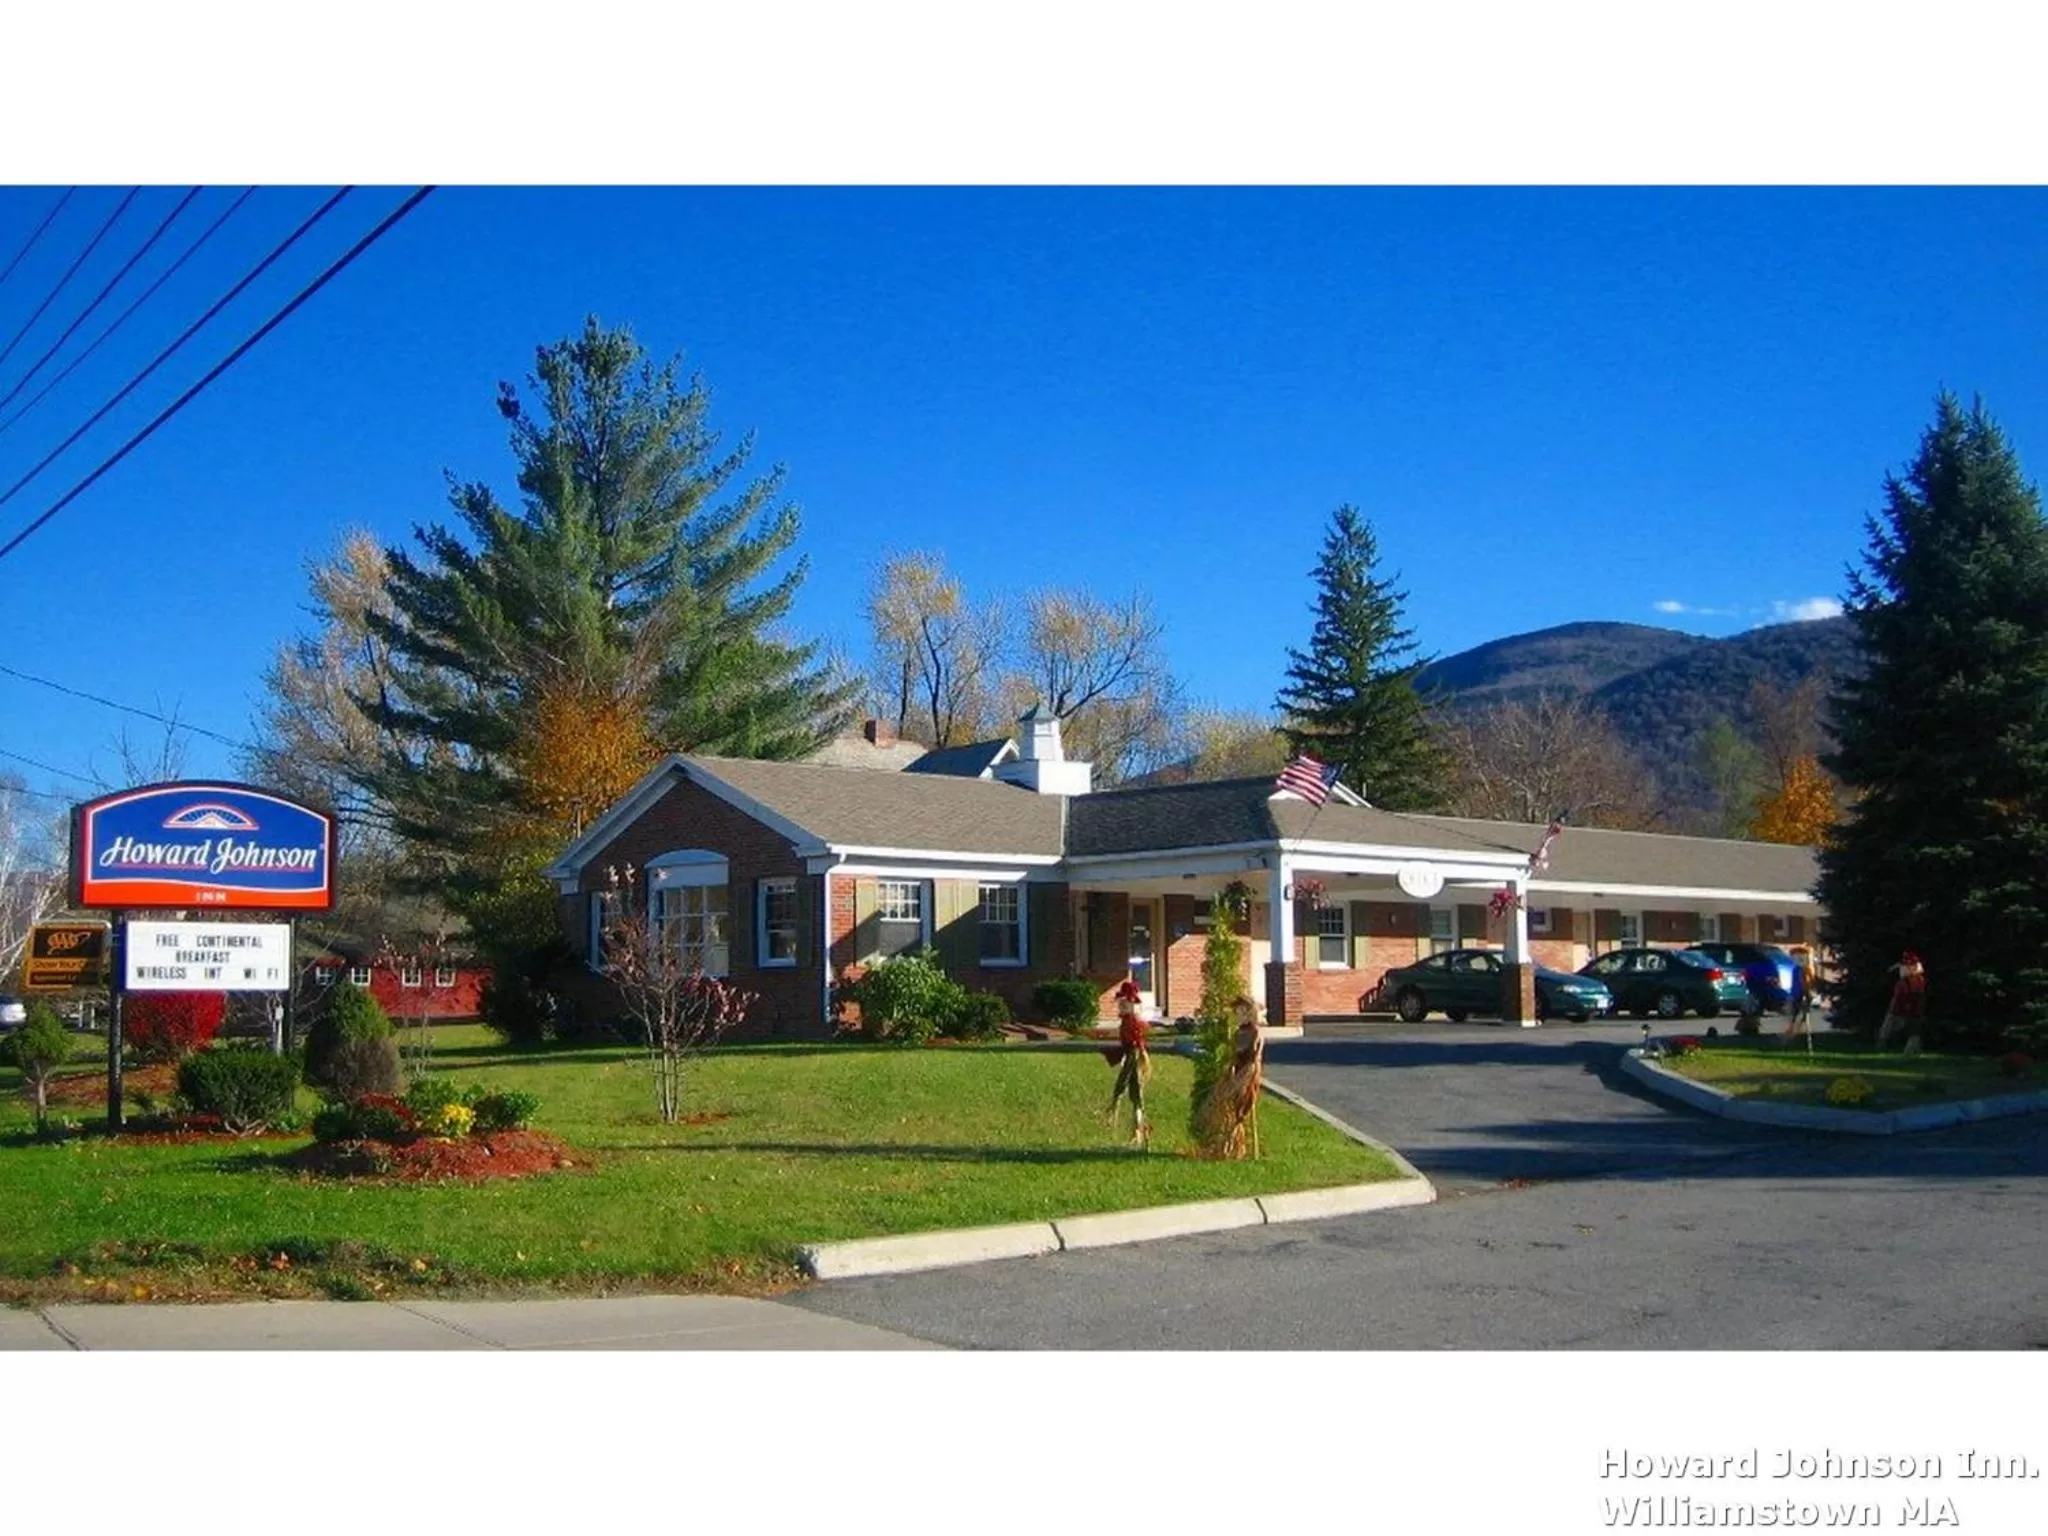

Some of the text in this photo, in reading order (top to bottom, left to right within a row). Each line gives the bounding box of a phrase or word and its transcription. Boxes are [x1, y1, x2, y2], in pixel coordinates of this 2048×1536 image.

[100, 837, 317, 874] Howard Johnson
[195, 891, 227, 903] INN
[156, 934, 263, 948] FREE CONTINENTAL
[176, 951, 231, 963] BREAKFAST
[136, 967, 187, 979] WIRELESS
[204, 967, 222, 979] INT
